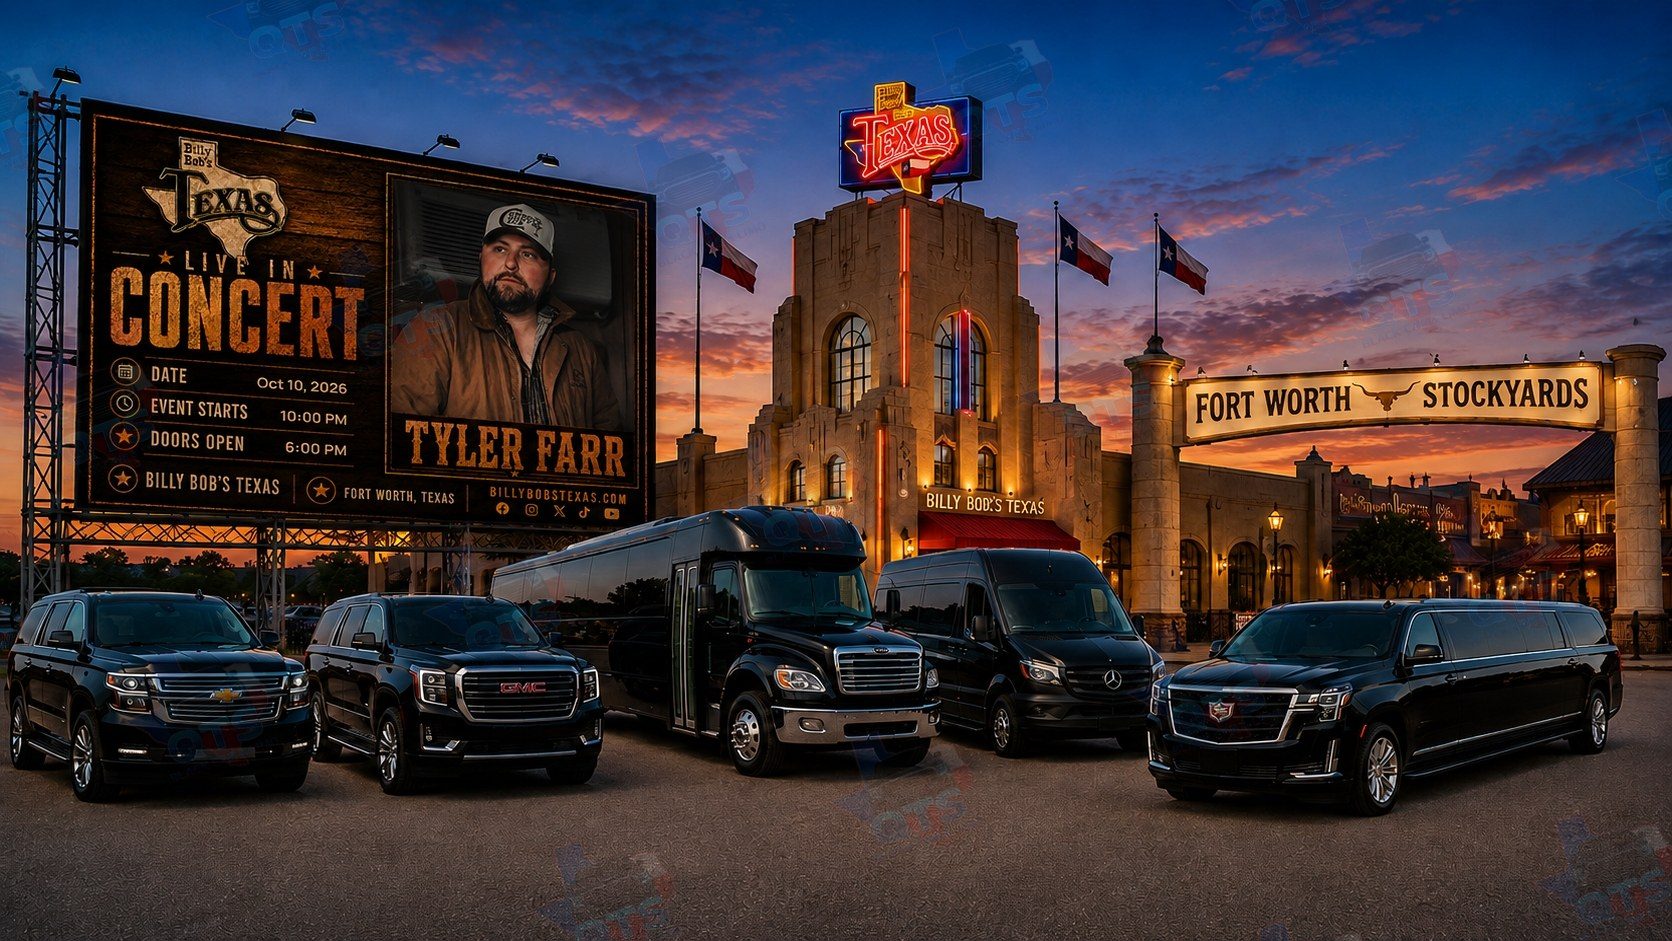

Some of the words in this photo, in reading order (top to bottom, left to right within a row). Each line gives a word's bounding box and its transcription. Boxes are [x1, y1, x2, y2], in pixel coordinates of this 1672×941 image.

[183, 143, 212, 157] Billy
[853, 115, 953, 178] TEXAS
[184, 155, 213, 168] Bob's
[185, 250, 247, 276] LIVE
[269, 259, 295, 280] IN
[110, 266, 365, 361] CONCERT
[151, 366, 187, 384] DATE
[257, 377, 284, 391] Oct
[288, 379, 307, 394] 10,
[311, 381, 348, 395] 2026
[151, 398, 194, 416] EVENT
[198, 401, 248, 420] STARTS
[1195, 391, 1255, 423] FORT
[1264, 385, 1352, 417] WORTH
[1422, 377, 1589, 409] STOCKYARDS
[280, 410, 322, 424] 10:00
[325, 413, 347, 426] PM
[151, 431, 200, 449] DOORS
[206, 434, 244, 452] OPEN
[285, 441, 320, 455] 6:00
[324, 444, 347, 456] PM
[405, 420, 525, 471] TYLER
[536, 430, 626, 477] FARR
[146, 472, 184, 490] BILLY
[190, 474, 230, 493] BOB'S
[236, 477, 280, 495] TEXAS
[344, 488, 371, 500] FORT
[376, 489, 416, 504] WORTH,
[421, 491, 455, 504] TEXAS
[489, 486, 627, 505] BILLYBOBSTEXAS.COM
[926, 493, 961, 510] BILLY
[1005, 499, 1045, 515] TEXAS
[500, 682, 547, 694] GMC
